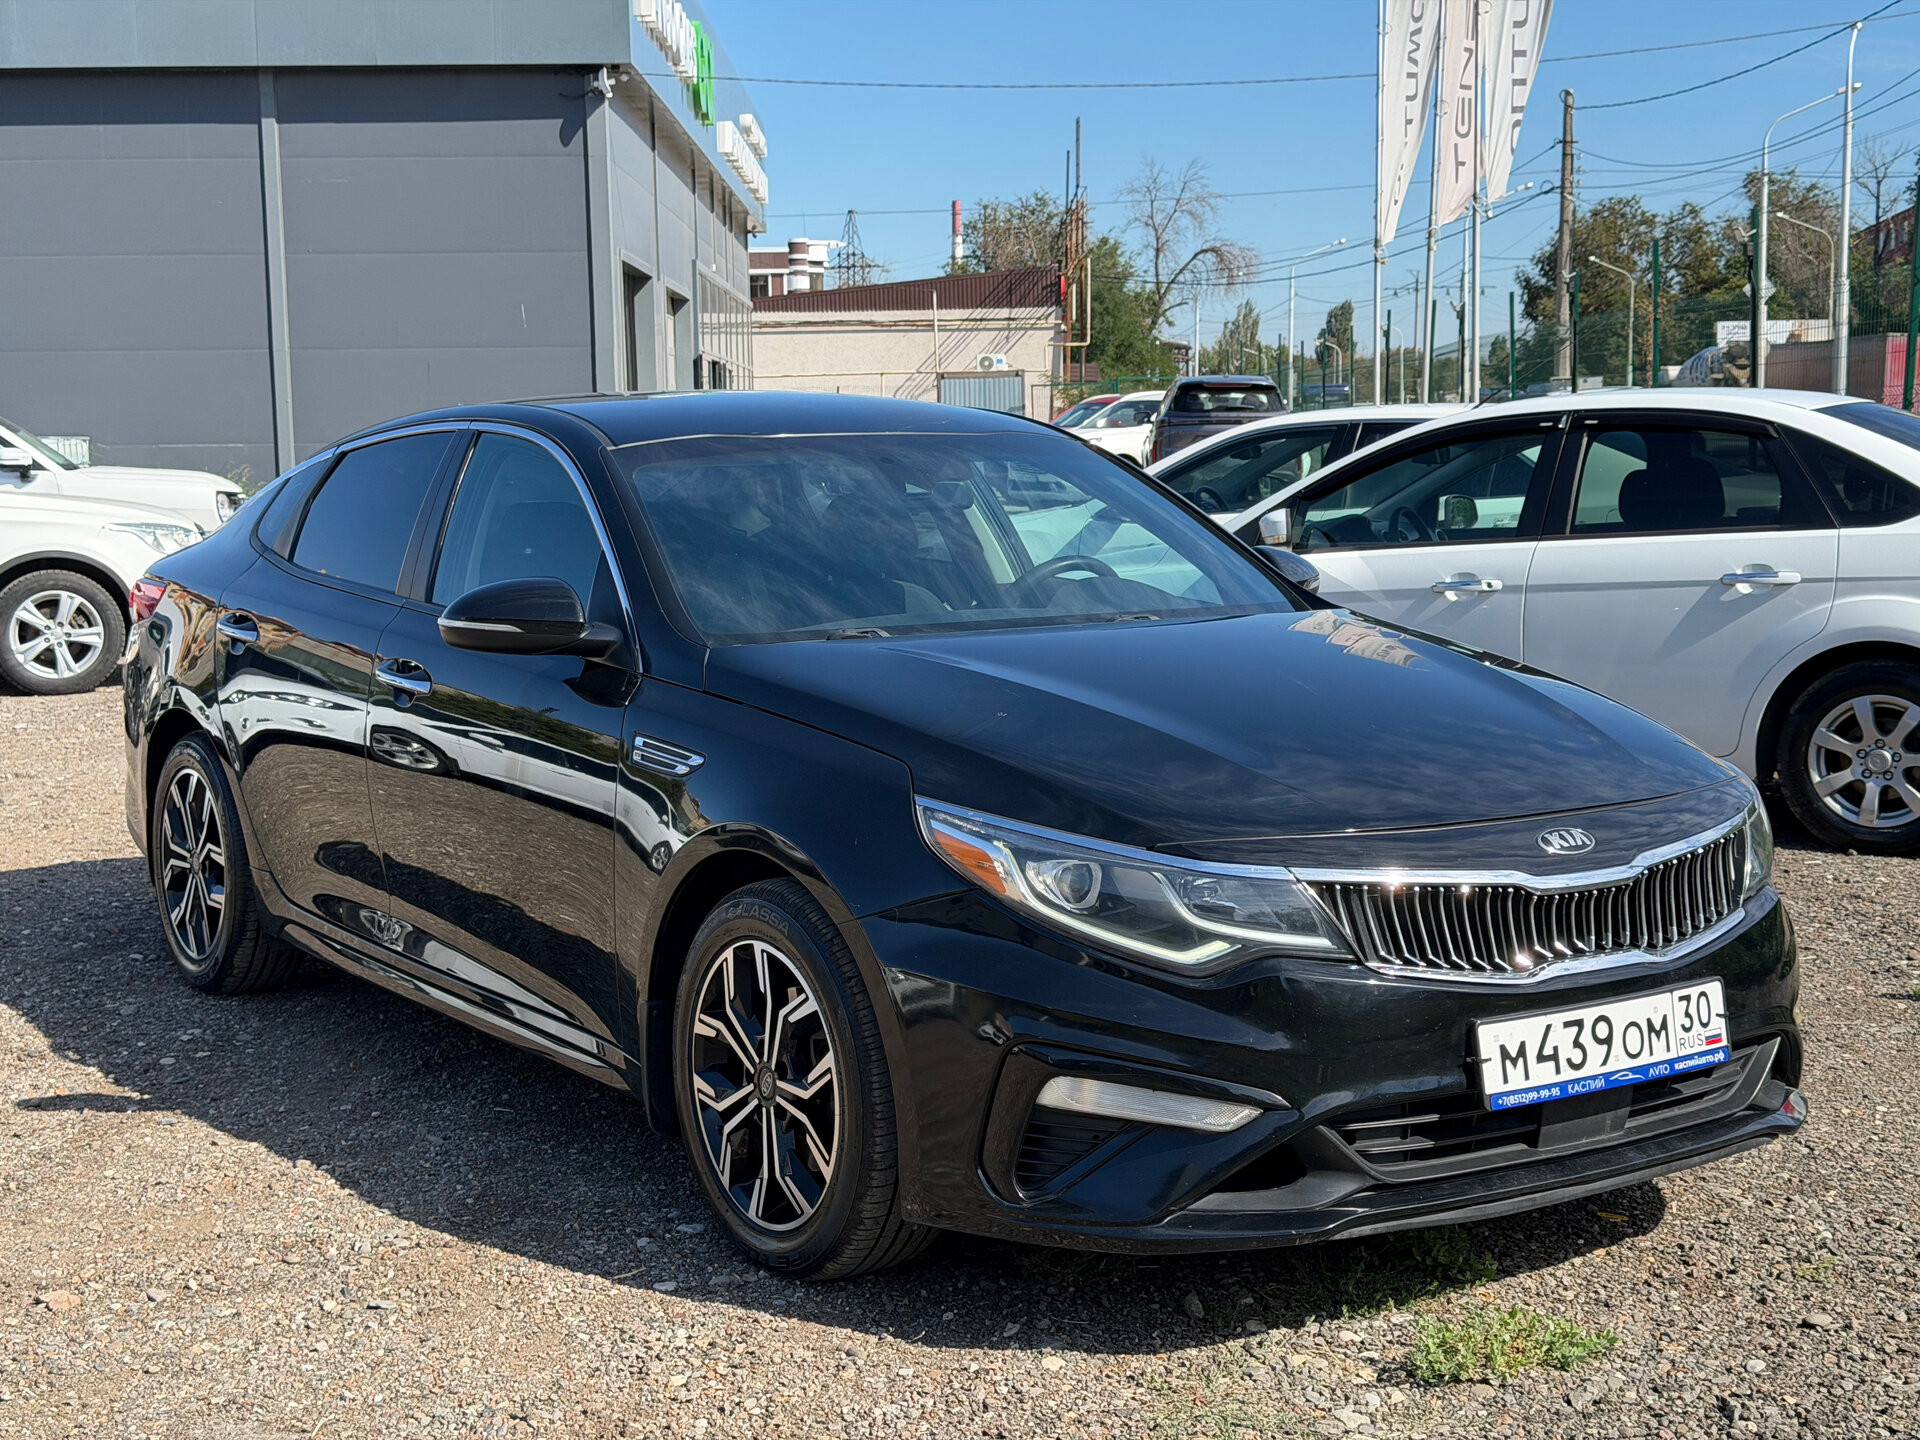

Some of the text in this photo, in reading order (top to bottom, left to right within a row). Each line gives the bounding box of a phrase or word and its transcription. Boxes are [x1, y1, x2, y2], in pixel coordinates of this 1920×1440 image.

[1543, 830, 1592, 849] KIA
[1678, 991, 1711, 1033] 30
[1679, 1031, 1705, 1051] RUS
[1497, 1087, 1561, 1106] +7(8512)99-99-95
[1567, 1076, 1605, 1095] КАСПИЙ
[1674, 1049, 1725, 1070] каспийавто.рф
